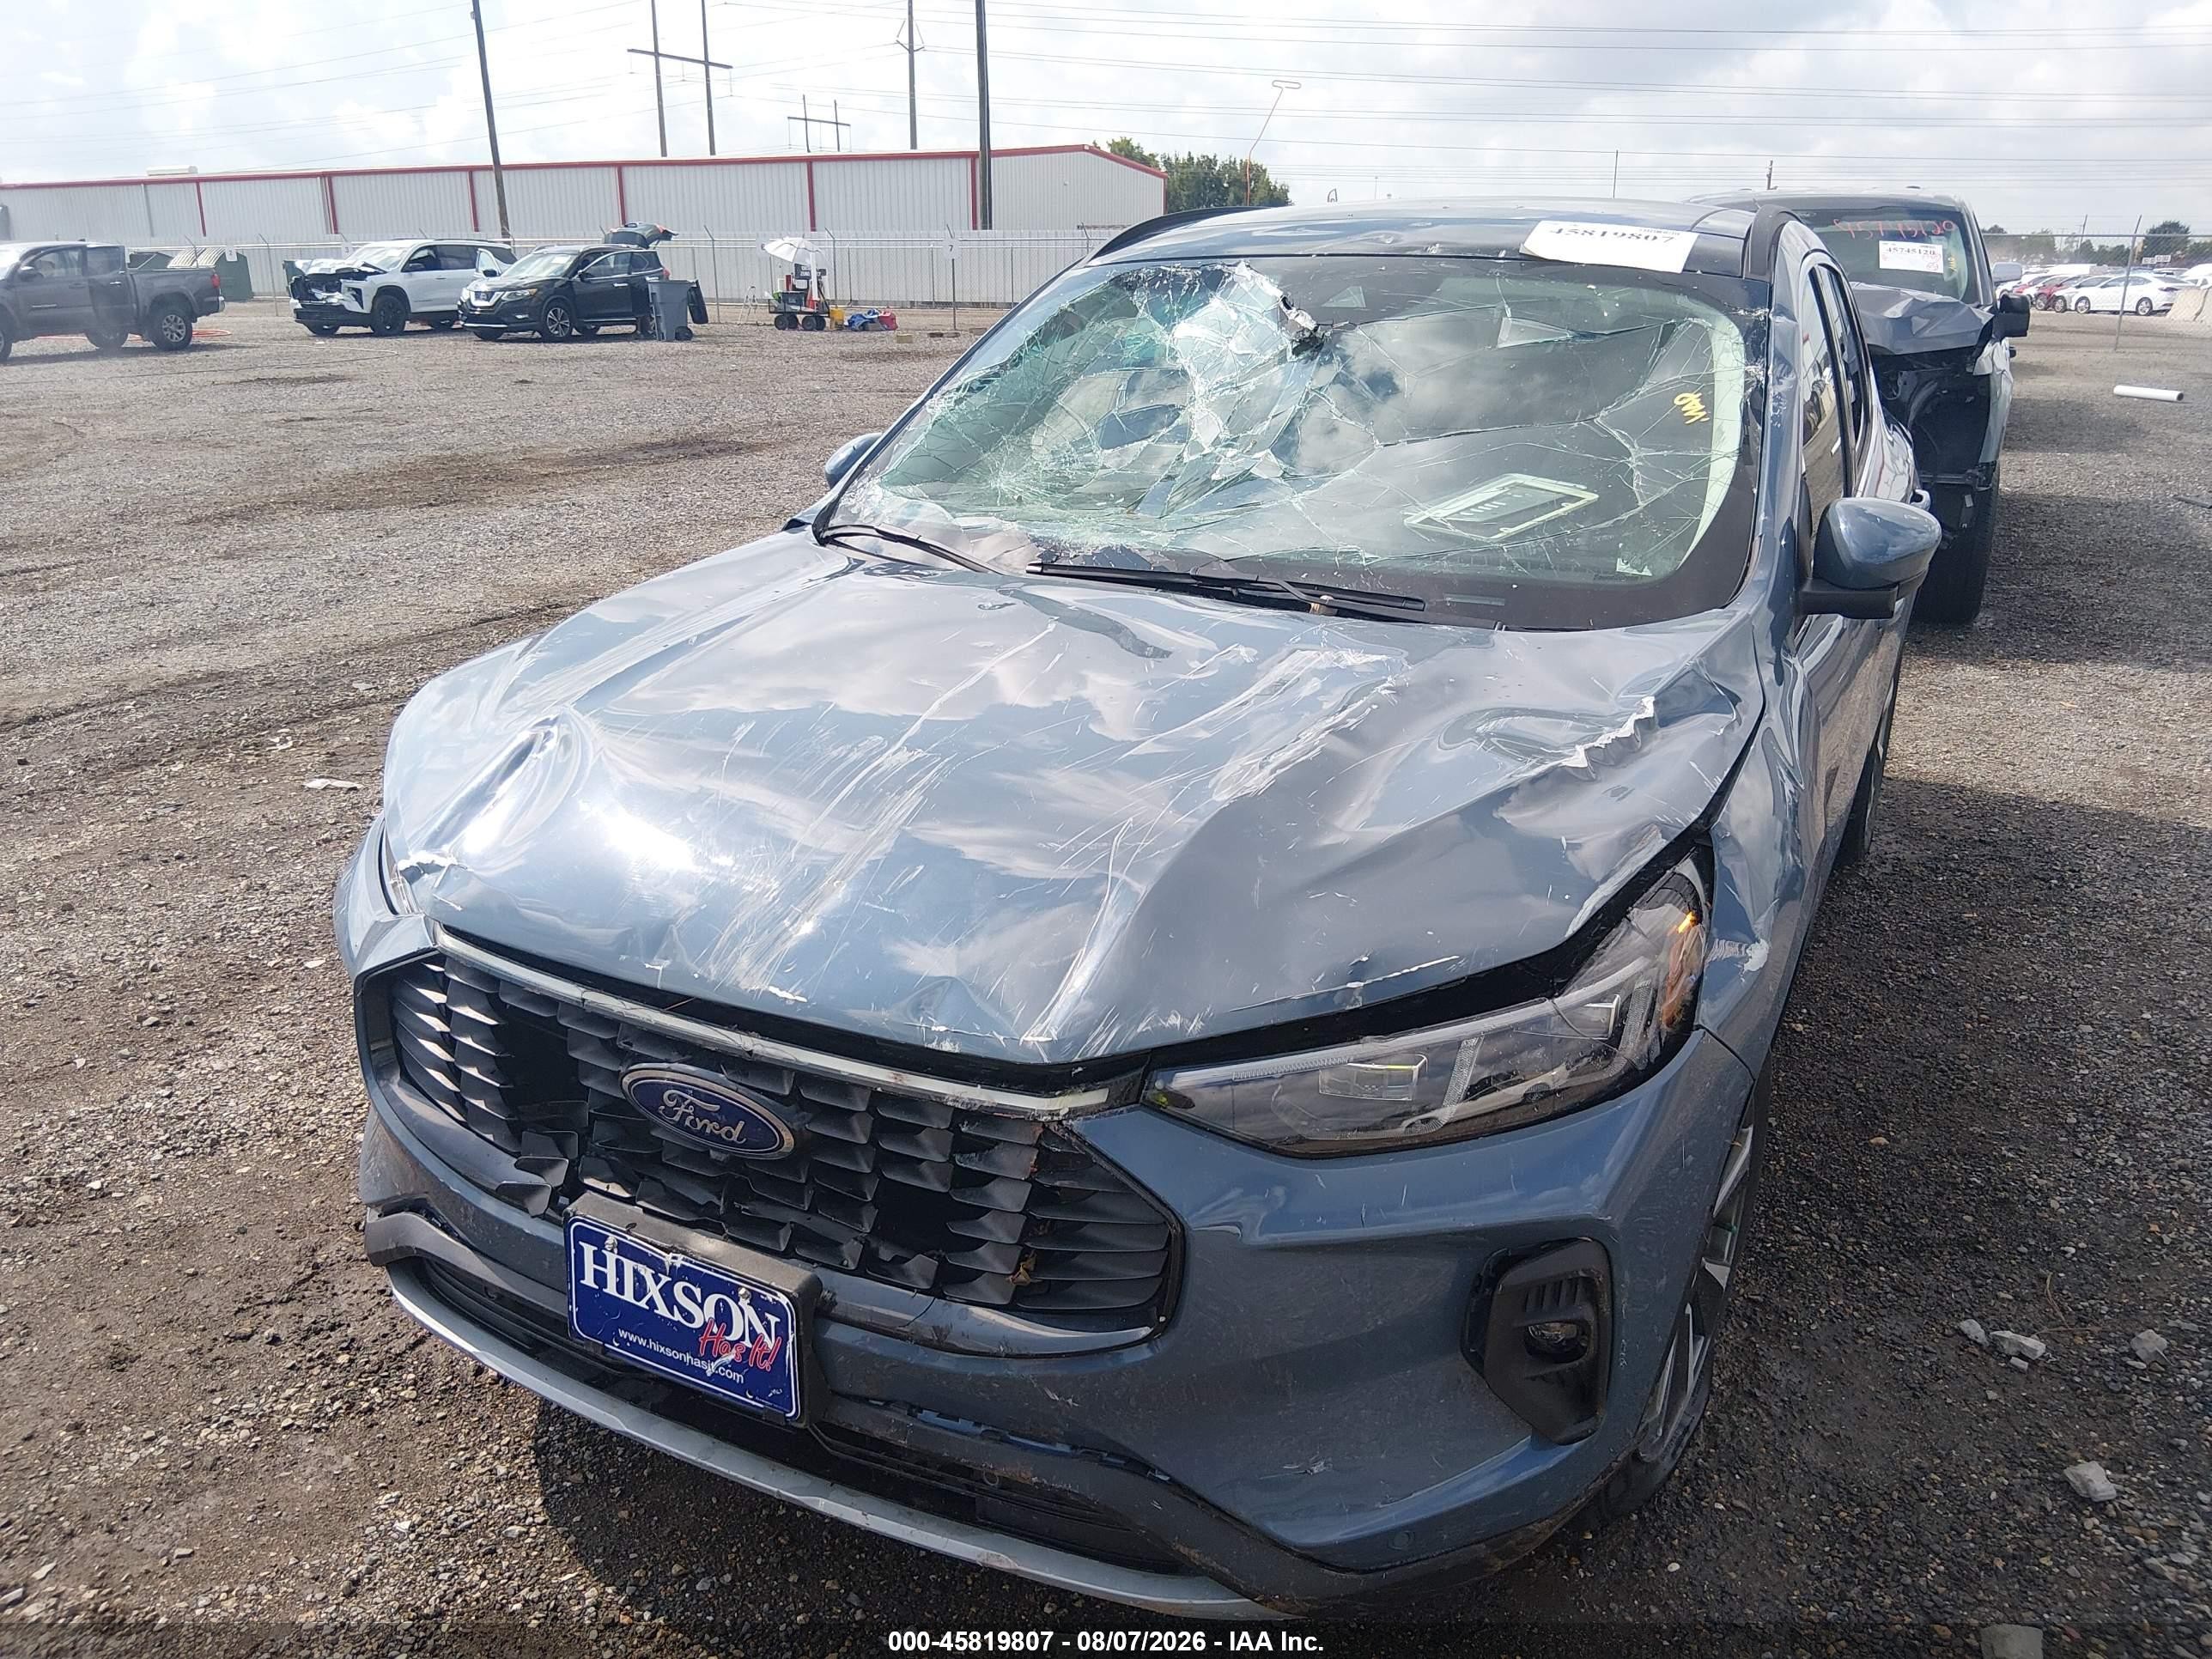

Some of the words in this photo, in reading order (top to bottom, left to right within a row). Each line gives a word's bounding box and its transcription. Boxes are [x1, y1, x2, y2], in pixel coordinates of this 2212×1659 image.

[948, 244, 954, 252] 7
[658, 1089, 747, 1145] Ford
[578, 1240, 781, 1351] HIXSON
[617, 1328, 745, 1385] www.hixsonhasit.com
[698, 1318, 746, 1364] Has
[748, 1332, 782, 1372] It!
